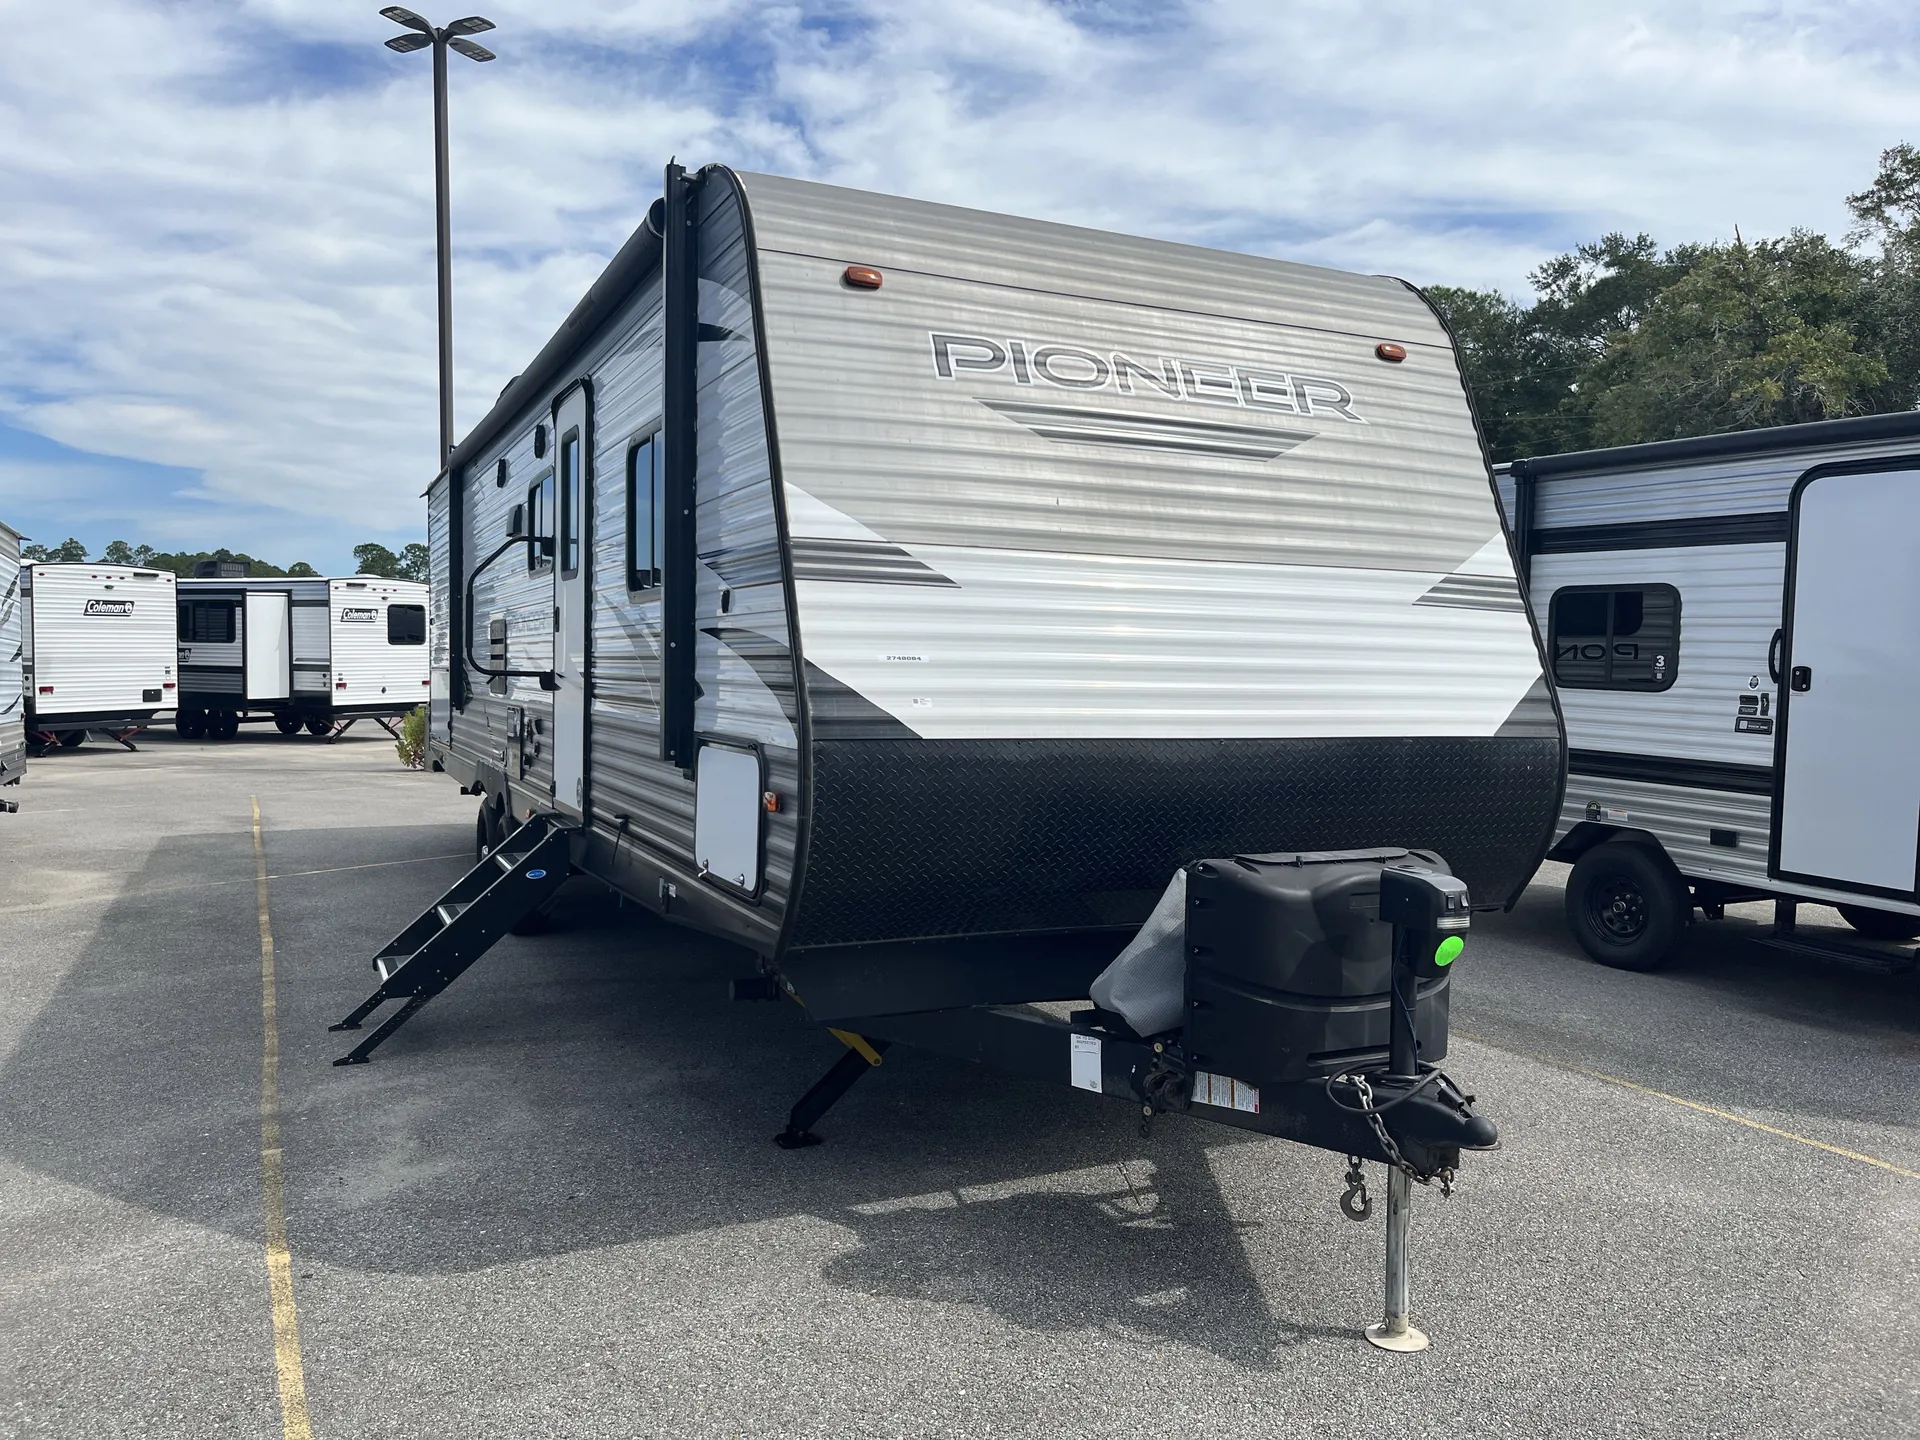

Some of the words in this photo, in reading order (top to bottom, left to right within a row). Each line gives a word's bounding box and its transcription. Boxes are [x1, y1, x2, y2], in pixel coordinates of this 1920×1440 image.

[929, 331, 1369, 424] PIONEER
[87, 600, 125, 613] Coleman
[343, 609, 371, 620] Coleman
[1655, 655, 1665, 667] 3
